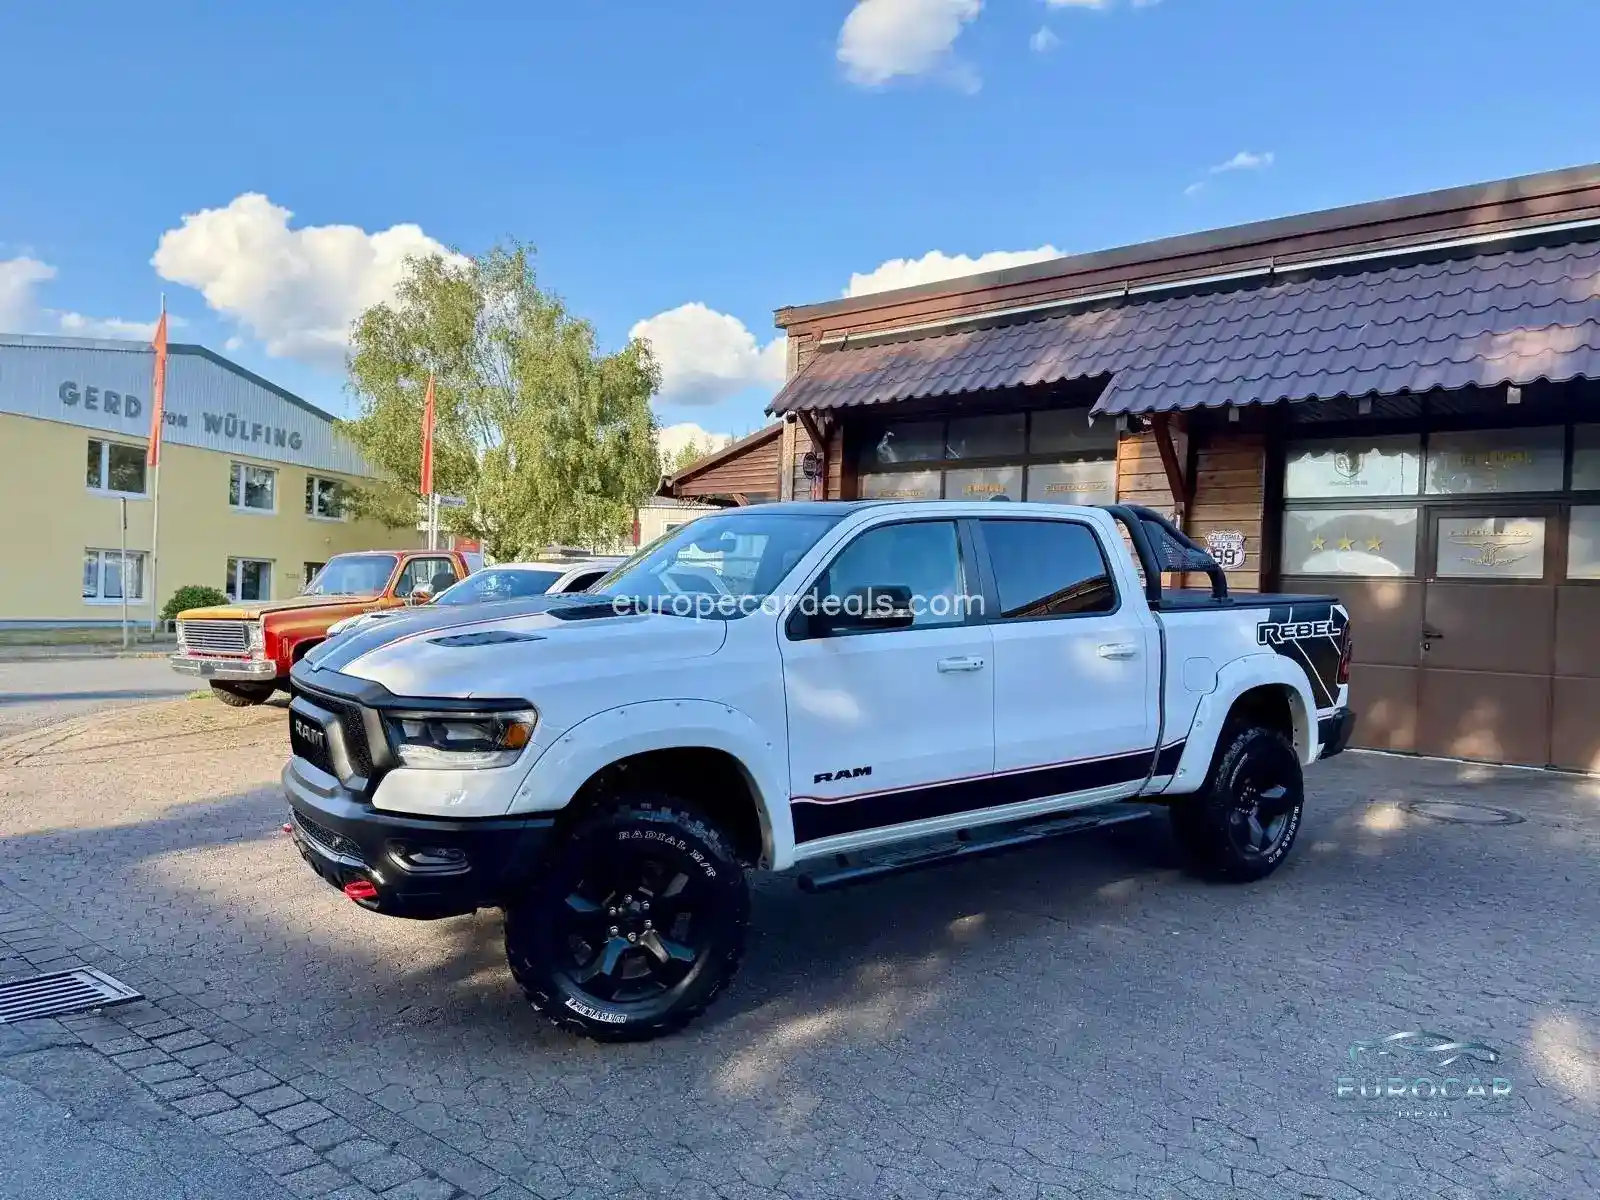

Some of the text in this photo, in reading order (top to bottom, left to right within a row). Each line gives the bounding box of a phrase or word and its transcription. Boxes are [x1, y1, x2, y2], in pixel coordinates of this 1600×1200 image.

[58, 380, 141, 418] GERD
[202, 412, 303, 450] WÜLFING
[1213, 549, 1236, 565] 99
[1257, 620, 1341, 645] REBEL
[295, 719, 324, 746] RAM
[813, 766, 872, 784] RAM
[618, 830, 686, 850] RADIAL
